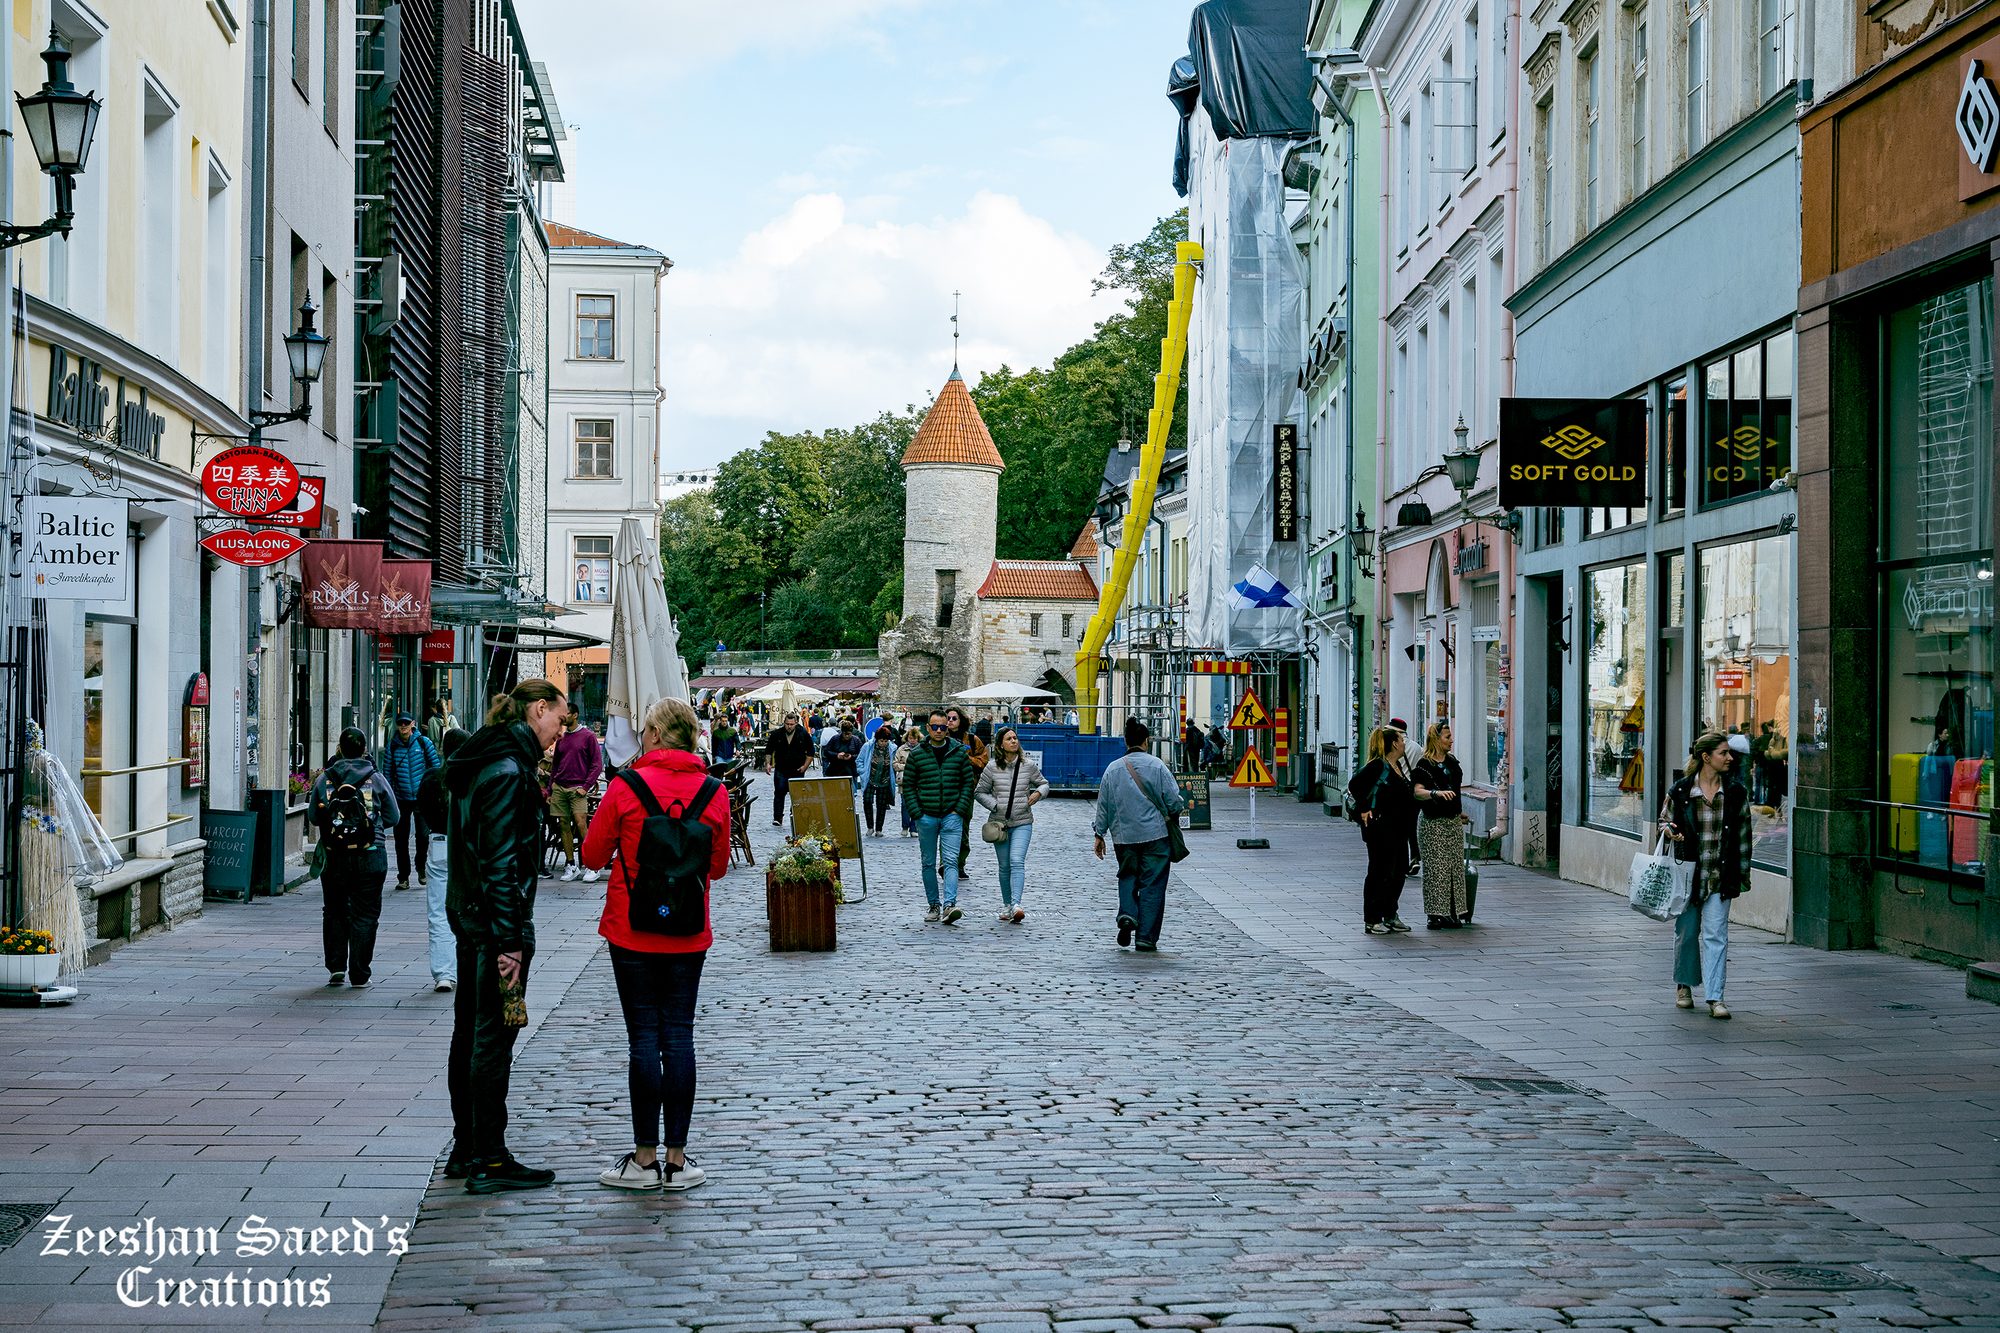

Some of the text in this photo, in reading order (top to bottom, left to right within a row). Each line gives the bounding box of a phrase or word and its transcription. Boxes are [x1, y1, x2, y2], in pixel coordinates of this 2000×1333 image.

[47, 344, 110, 437] Baltic
[212, 465, 291, 488] 四季美
[1510, 464, 1636, 482] SOFT GOLD
[300, 481, 320, 496] RID
[1279, 427, 1293, 539] PAPARAZZI
[216, 486, 283, 502] CHINA
[231, 499, 267, 513] INN
[36, 512, 115, 537] Baltic
[296, 515, 304, 523] 9
[216, 539, 290, 549] ILUSALONG
[28, 540, 120, 566] Amber
[207, 840, 246, 852] EDICURE
